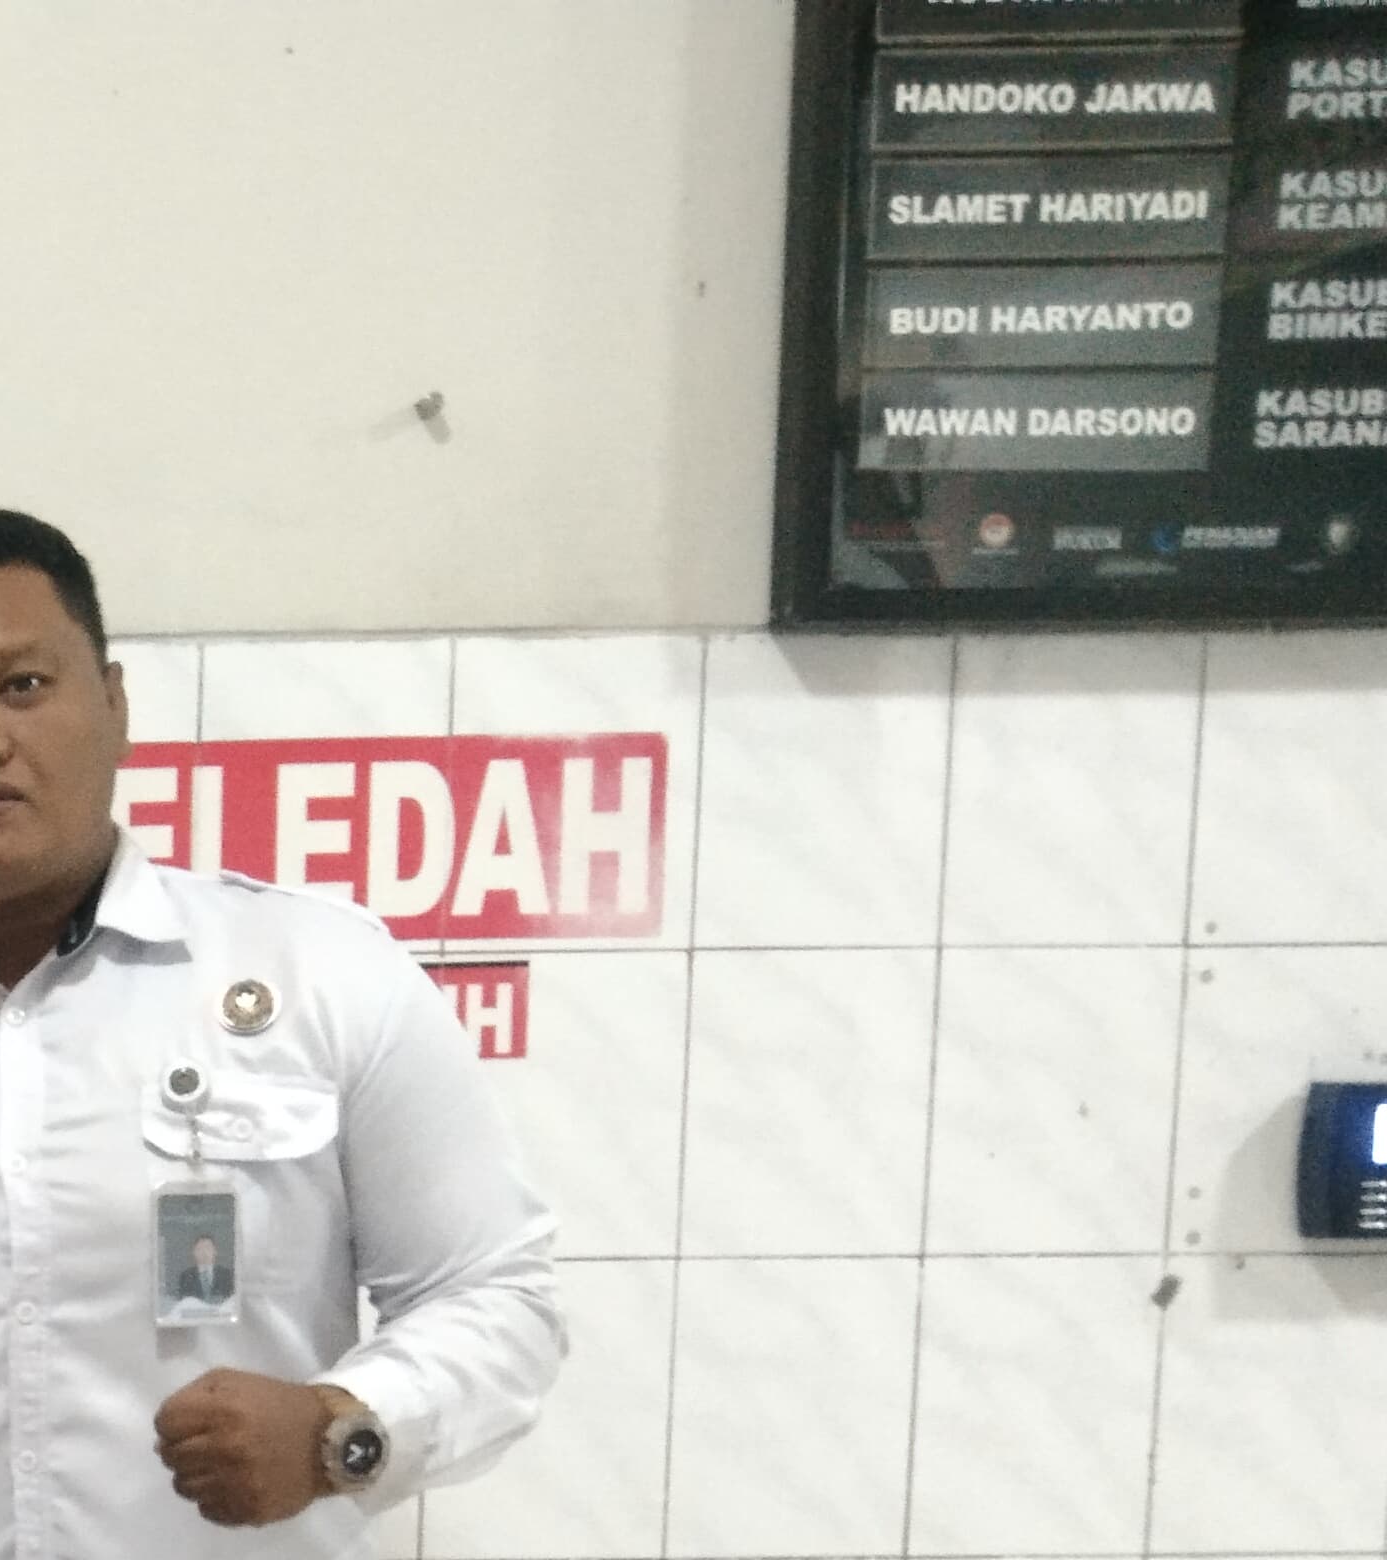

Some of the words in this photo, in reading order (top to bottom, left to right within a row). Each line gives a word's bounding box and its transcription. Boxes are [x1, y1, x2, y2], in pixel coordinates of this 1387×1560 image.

[894, 82, 1075, 114] HANDOKO
[1084, 82, 1215, 113] JAKWA
[889, 194, 1030, 224] SLAMET
[1039, 190, 1208, 222] HARIYADI
[890, 306, 978, 335] BUDI
[991, 301, 1193, 332] HARYANTO
[1256, 388, 1385, 417] KASUB
[884, 409, 1018, 436] WAWAN
[1028, 408, 1195, 436] DARSONO
[1253, 420, 1387, 447] SARAN
